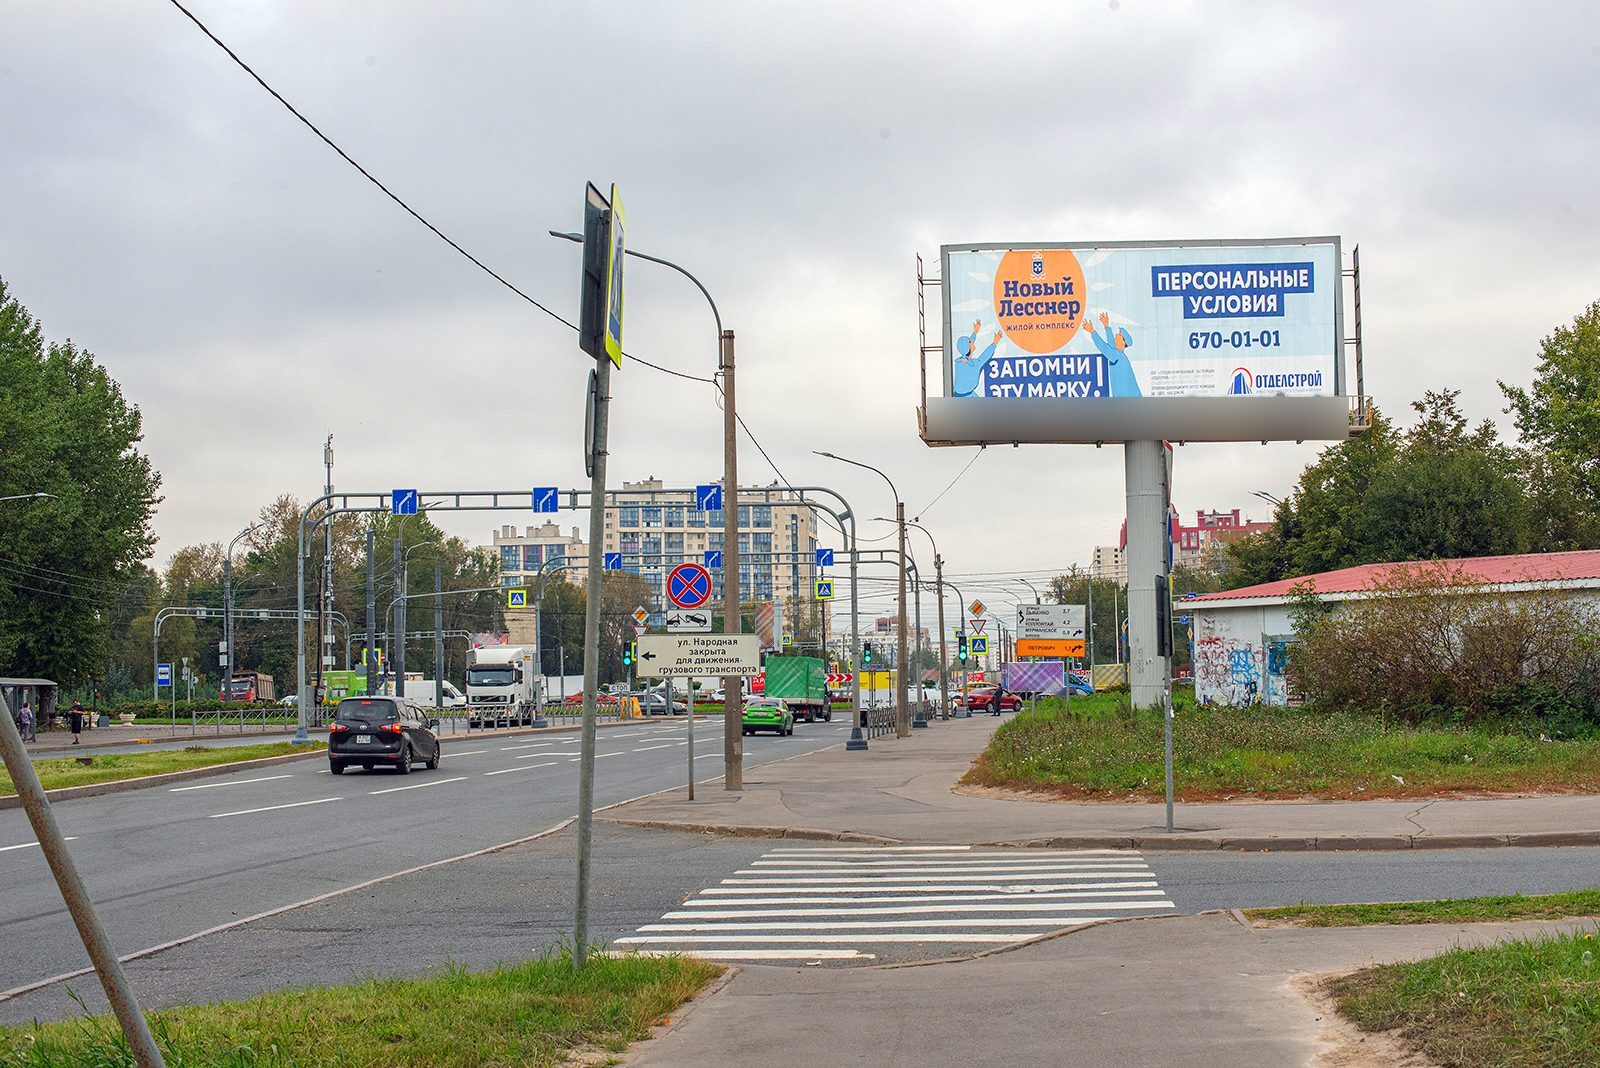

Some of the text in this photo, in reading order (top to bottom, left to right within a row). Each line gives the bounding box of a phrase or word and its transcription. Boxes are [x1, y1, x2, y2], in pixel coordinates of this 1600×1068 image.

[1003, 277, 1074, 298] Новый
[1157, 269, 1309, 291] ПЕРСОНАЛЬНЫЕ
[998, 300, 1081, 320] Лесснер
[1189, 294, 1278, 314] УСЛОВИЯ
[1006, 322, 1075, 331] ЖИЛОЙ КОМПЛЕКС
[1188, 330, 1281, 349] 670-01-01
[988, 357, 1091, 379] ЗАПОМНИ
[1255, 370, 1322, 388] ОТДЕЛСТРОЙ
[989, 384, 1024, 398] ЭТУ
[677, 638, 738, 647] ул. Народная
[676, 657, 693, 665] для
[689, 648, 726, 656] закрыта
[658, 666, 757, 675] грузового транспорта
